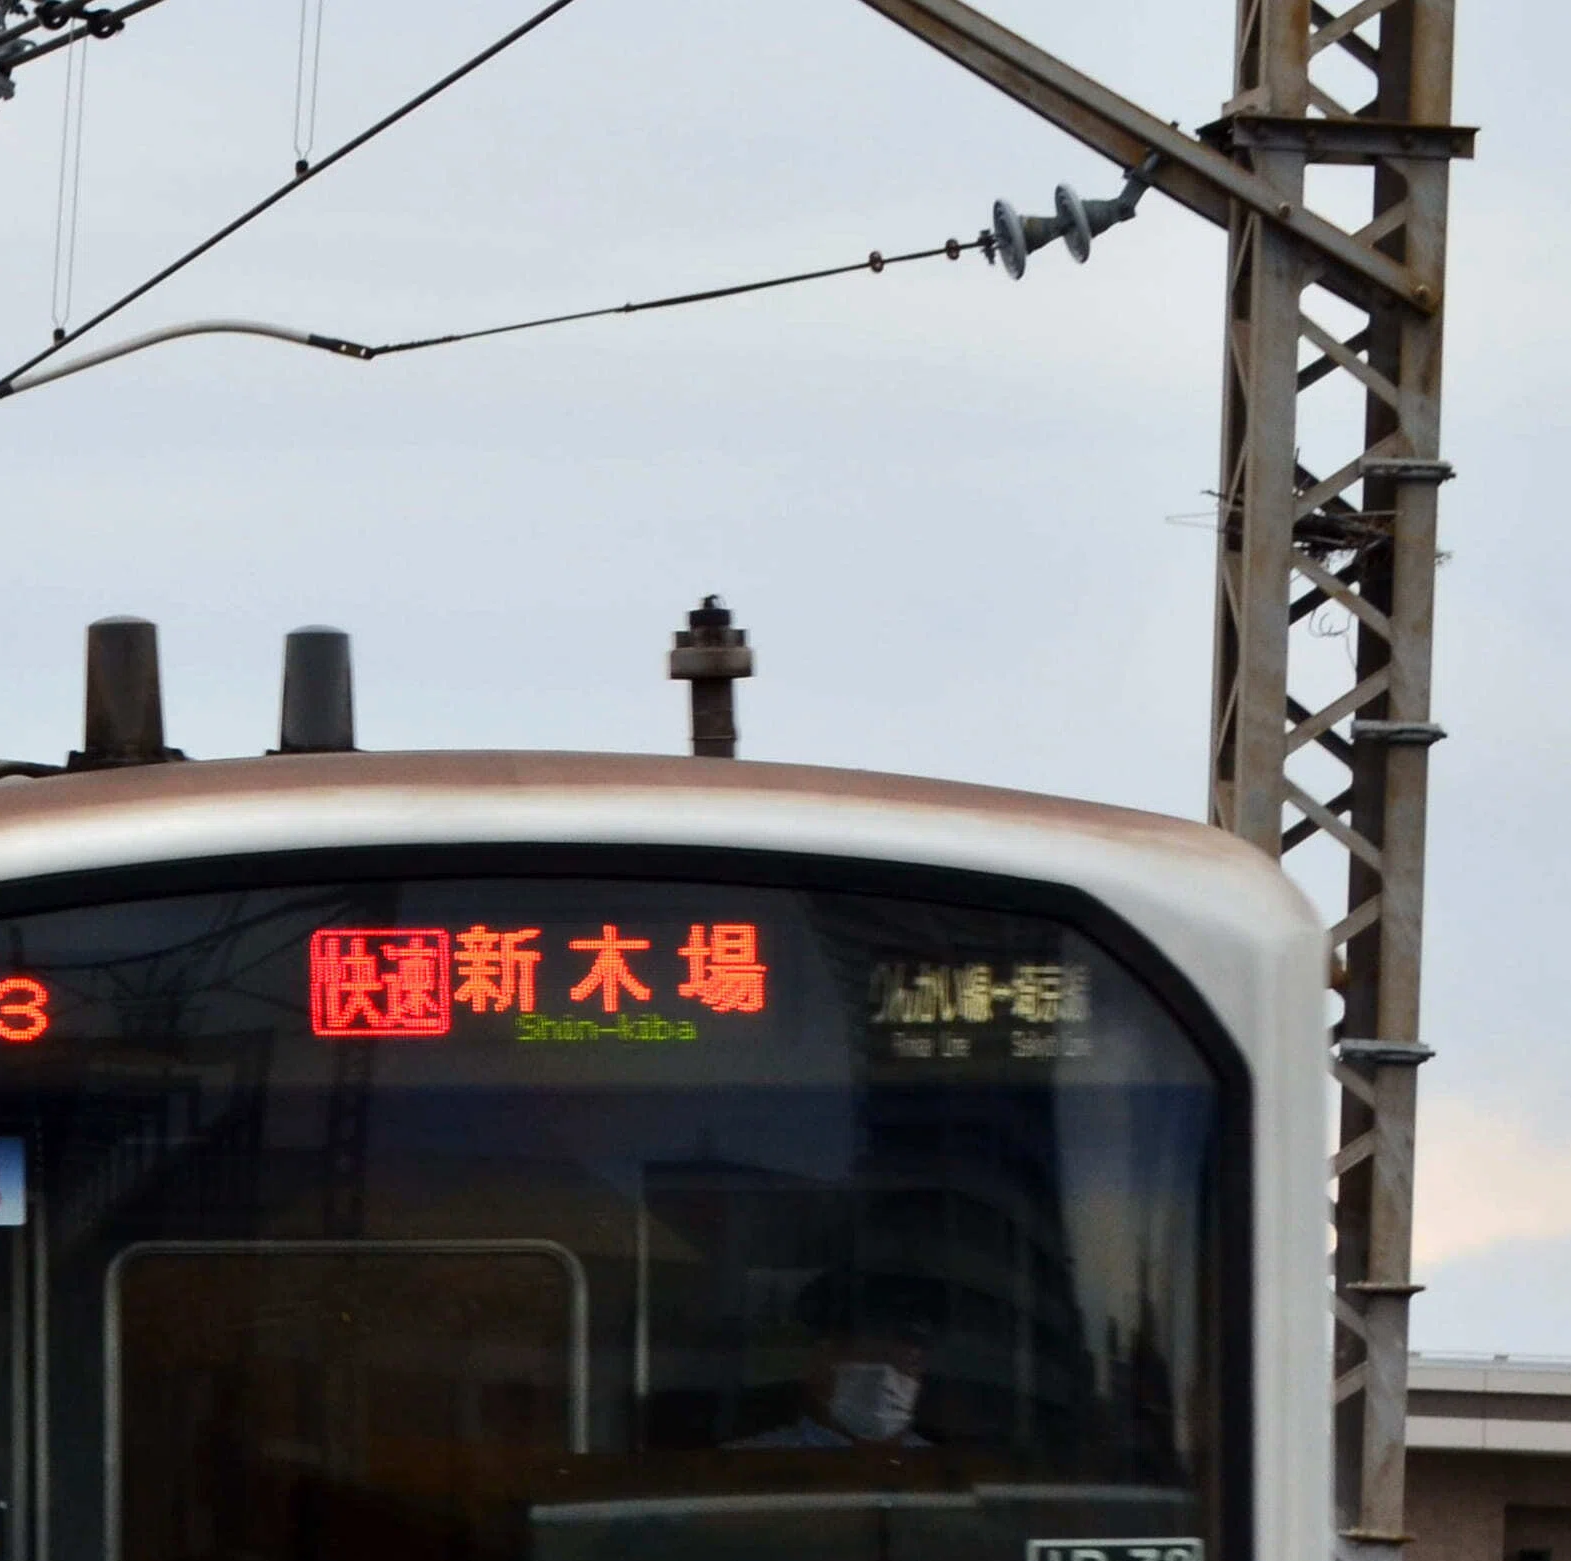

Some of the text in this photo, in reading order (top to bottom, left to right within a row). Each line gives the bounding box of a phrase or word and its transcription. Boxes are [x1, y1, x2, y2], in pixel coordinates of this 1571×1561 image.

[455, 924, 767, 1013] 新木場
[515, 1013, 697, 1041] Shin-kiba
